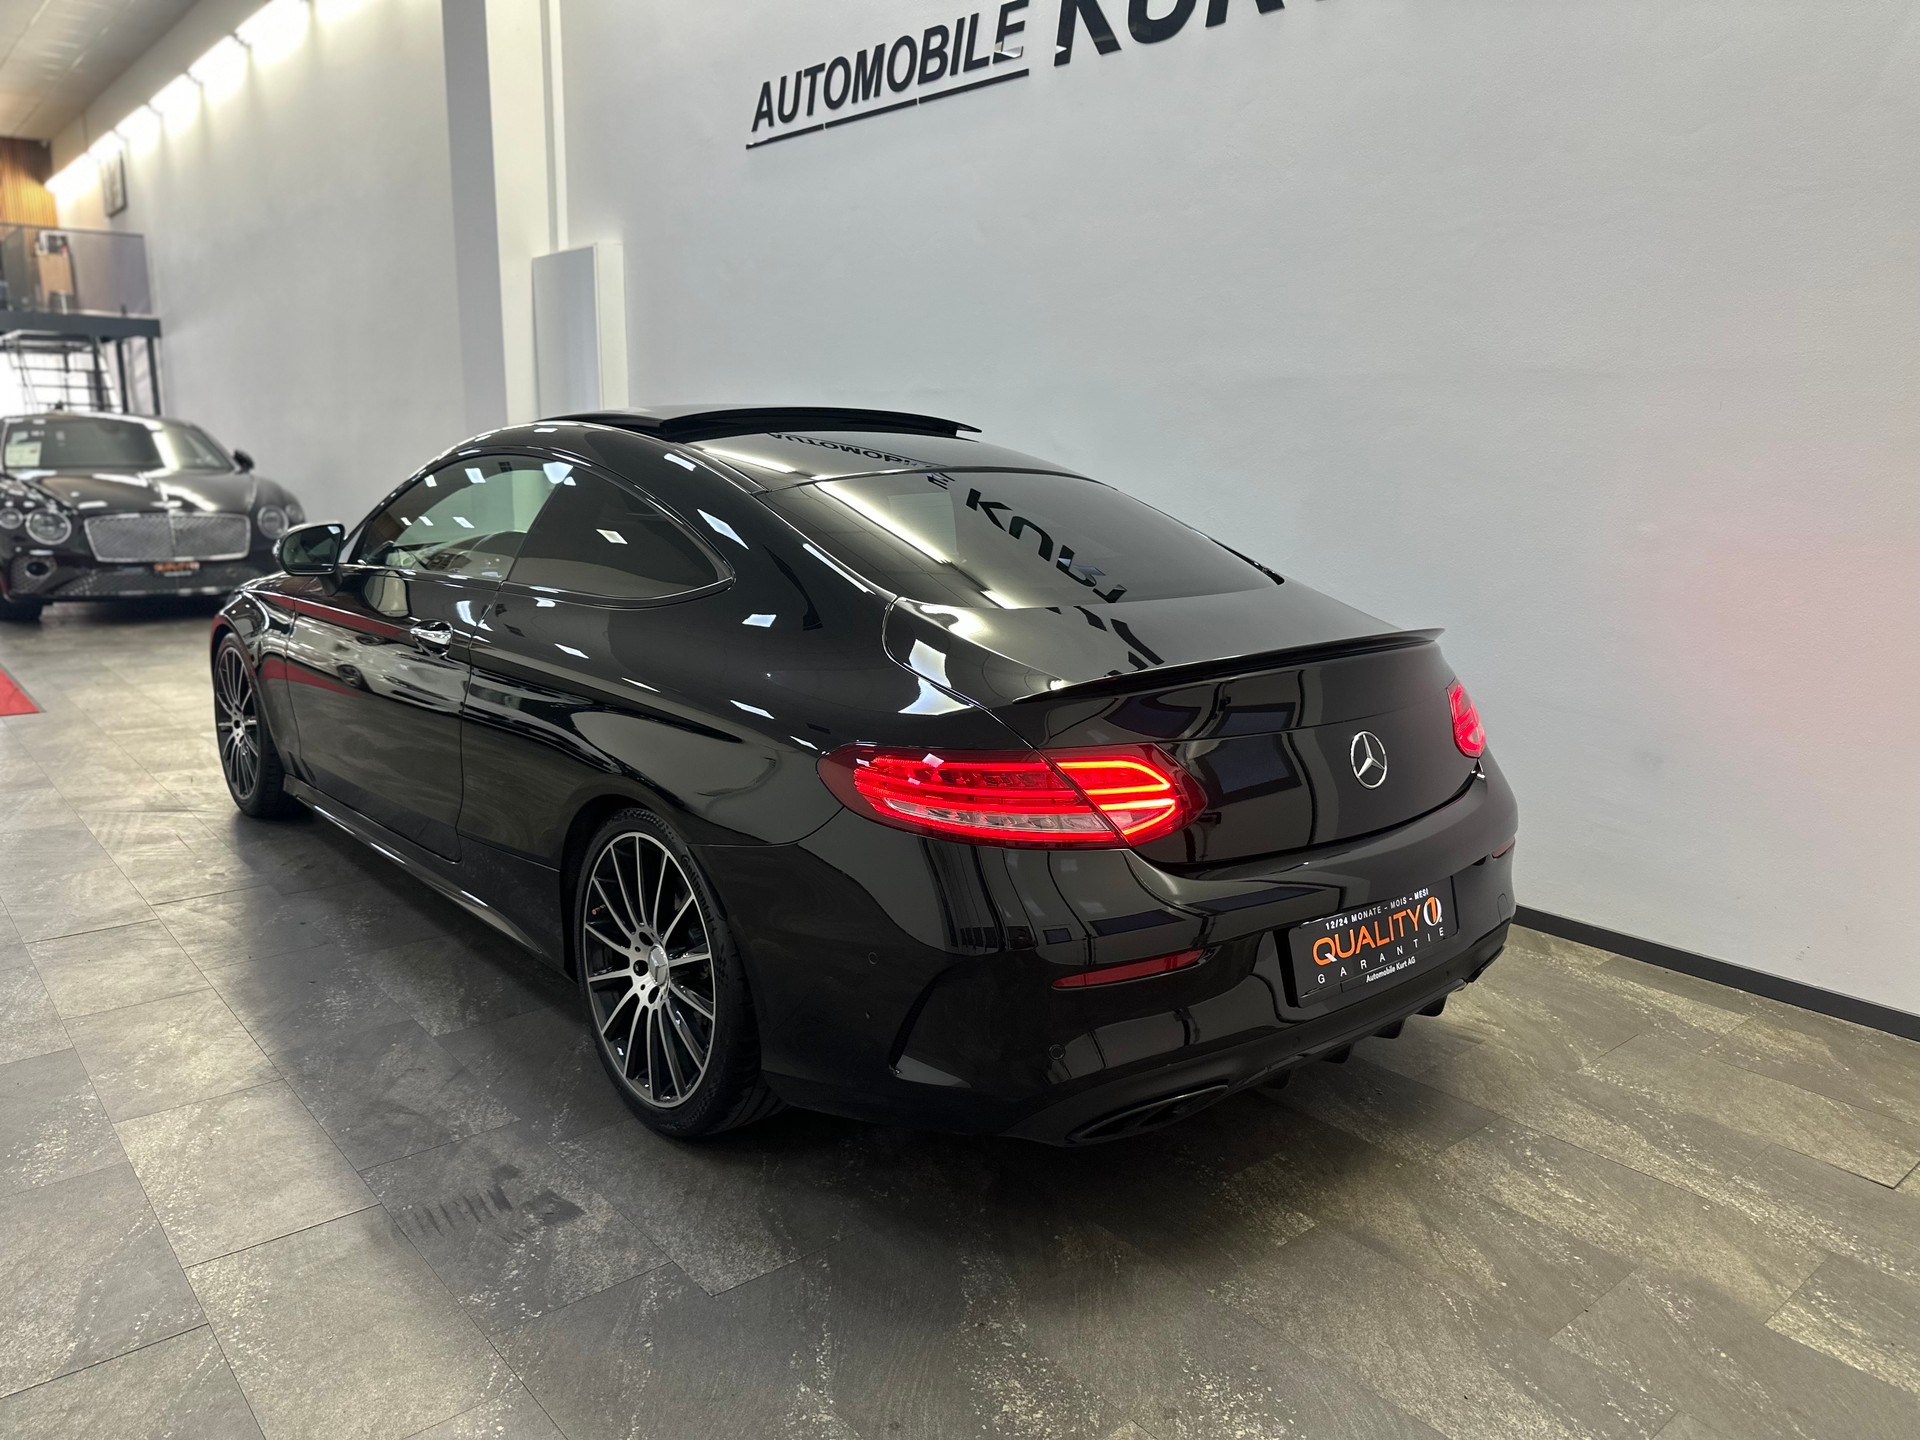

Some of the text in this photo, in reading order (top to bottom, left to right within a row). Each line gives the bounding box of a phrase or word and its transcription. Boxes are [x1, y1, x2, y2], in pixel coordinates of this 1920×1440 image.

[751, 0, 1029, 132] AUTOMOBILE
[1312, 904, 1421, 966] QUALITY
[1325, 917, 1348, 930] 12/24
[1351, 905, 1382, 922] MONATE
[1390, 897, 1407, 909] MOIS
[1414, 887, 1429, 900] MESI
[1317, 926, 1444, 984] GARANTIE
[1366, 955, 1416, 983] Automobile Kurt AG
